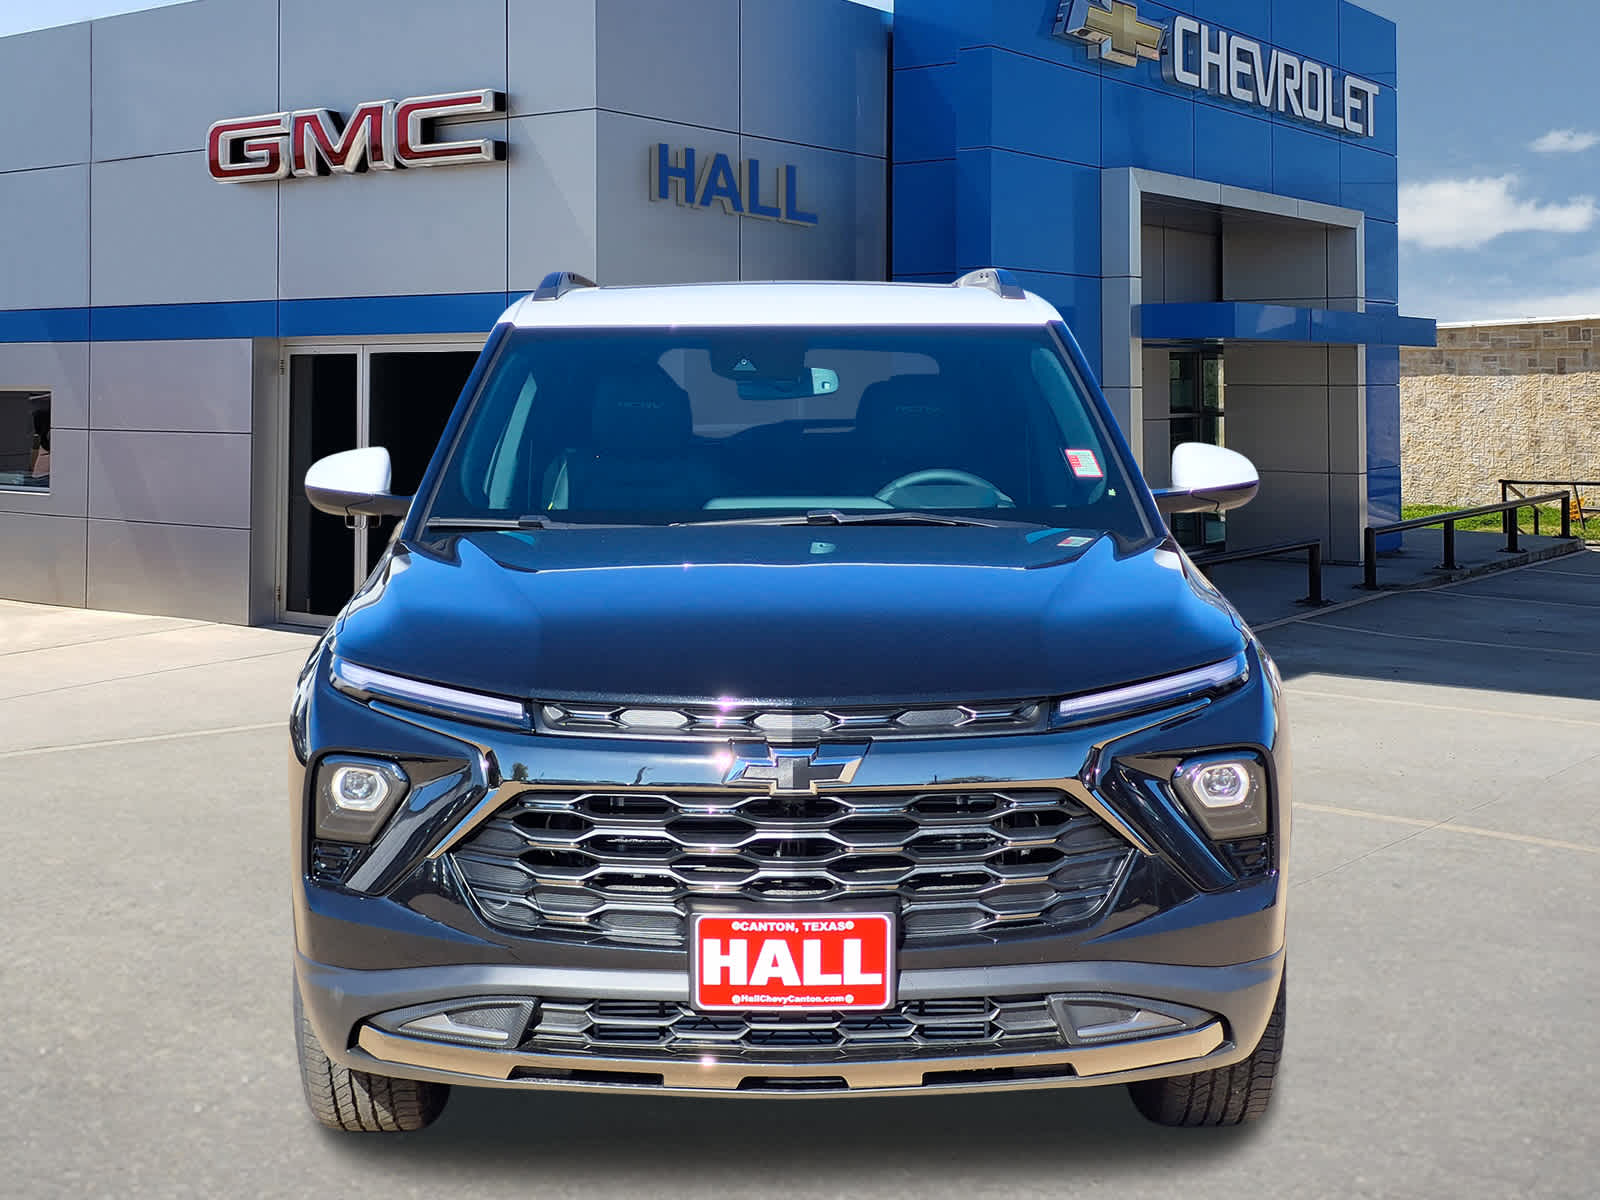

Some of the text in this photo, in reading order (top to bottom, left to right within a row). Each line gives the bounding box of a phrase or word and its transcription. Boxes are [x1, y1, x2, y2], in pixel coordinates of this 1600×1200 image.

[1174, 14, 1380, 137] CHEVROLET
[205, 88, 507, 185] GMC
[654, 142, 820, 226] HALL
[703, 938, 883, 986] HALL
[739, 921, 846, 933] CANTON, TEXAS
